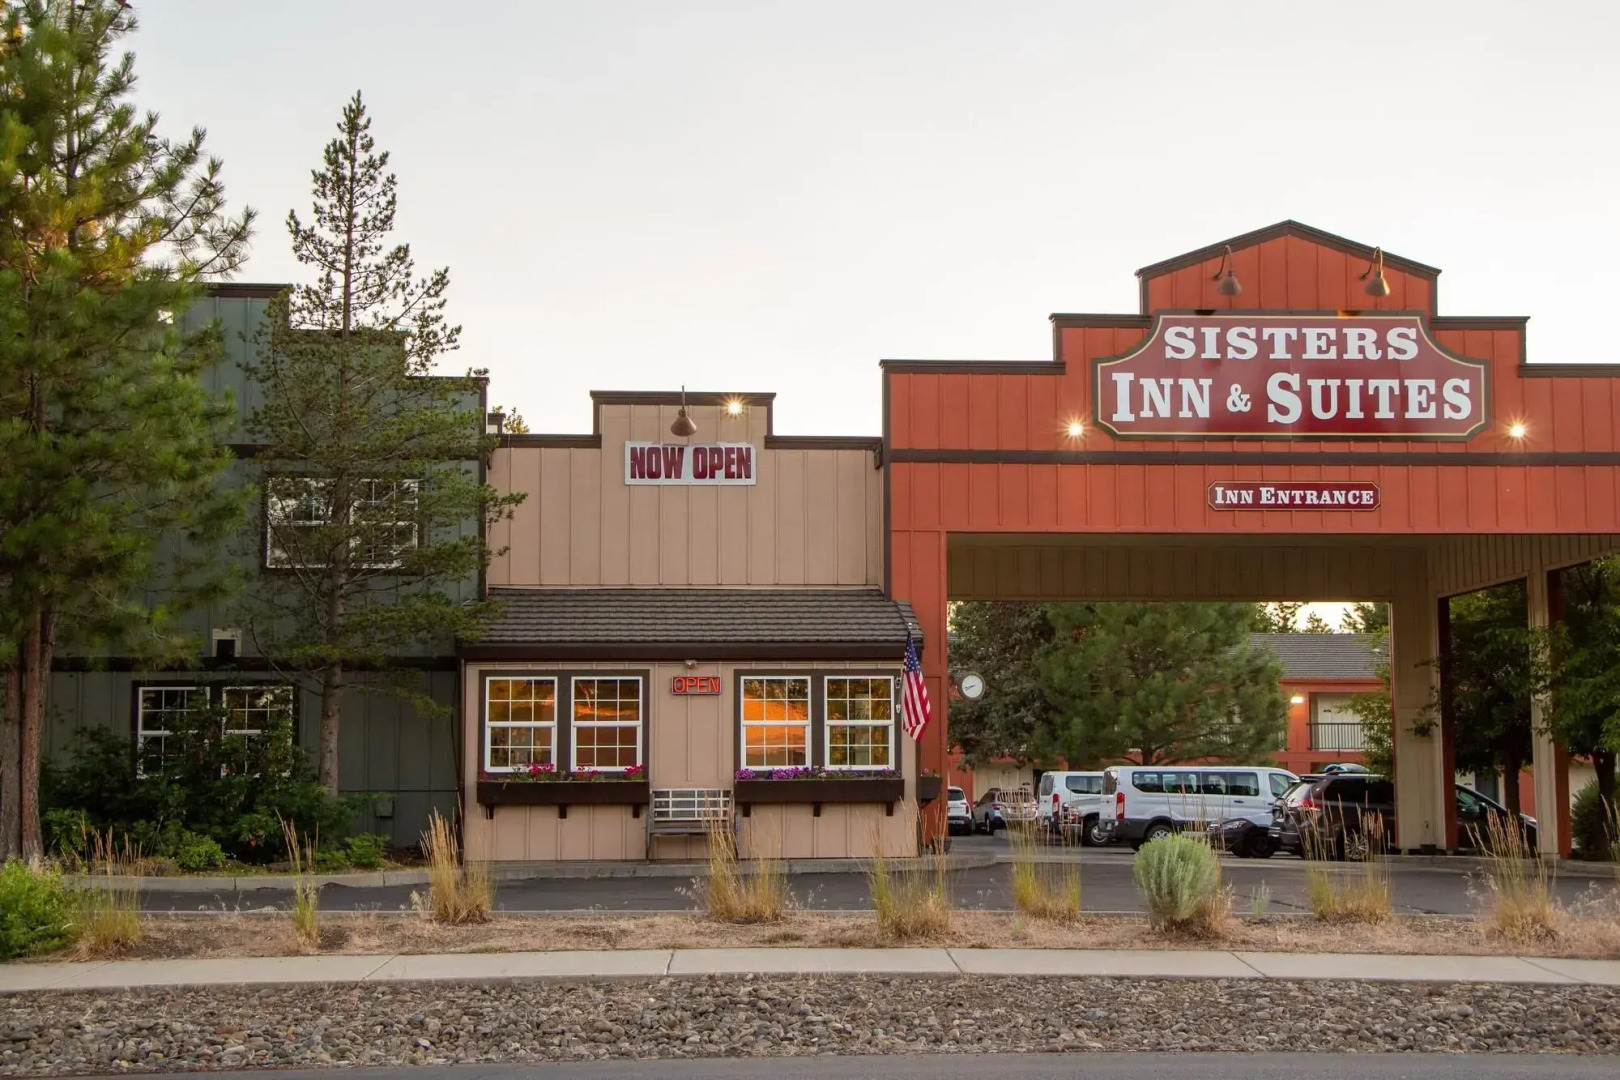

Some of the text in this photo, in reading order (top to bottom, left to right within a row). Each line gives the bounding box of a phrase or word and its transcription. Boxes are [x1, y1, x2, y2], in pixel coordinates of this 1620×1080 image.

[1164, 326, 1419, 360] SISTERS
[1111, 371, 1472, 424] INN & SUITES
[630, 446, 752, 480] NOW OPEN
[1215, 487, 1374, 504] INN ENTRANCE
[673, 677, 720, 693] OPEN
